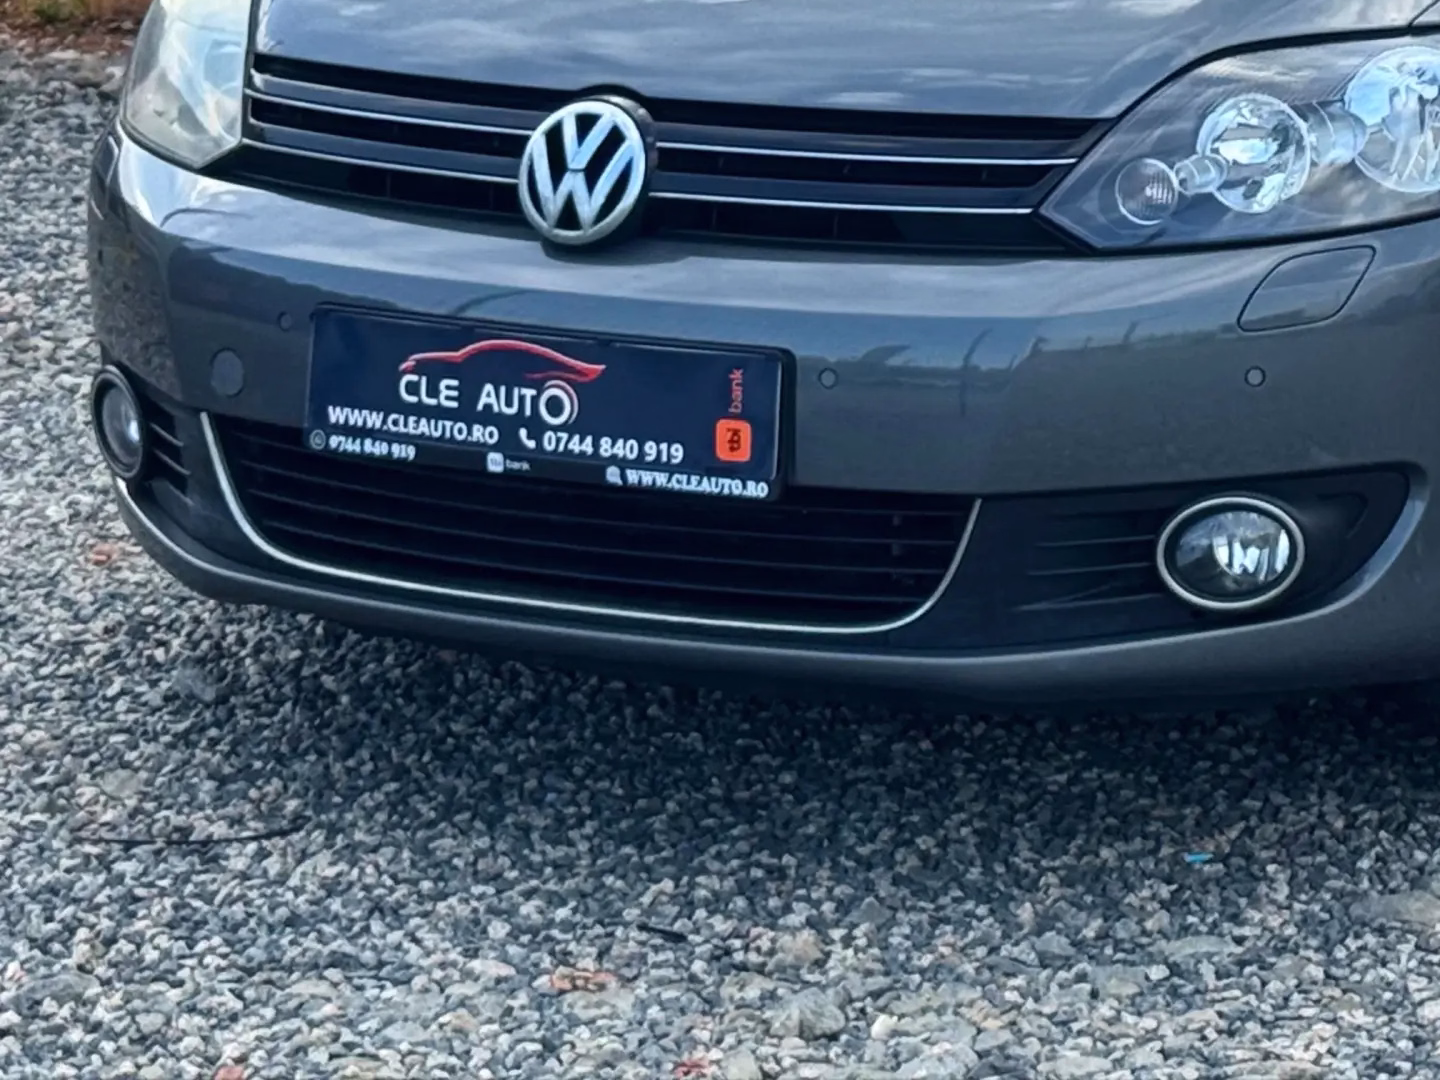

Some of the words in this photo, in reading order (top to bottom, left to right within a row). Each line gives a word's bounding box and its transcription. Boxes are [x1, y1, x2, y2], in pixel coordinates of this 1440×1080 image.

[399, 373, 460, 408] CLE
[476, 382, 573, 426] AUTO
[728, 368, 744, 414] bank
[328, 405, 499, 445] WWW.CLEAUTO.RO
[328, 434, 361, 454] 0744
[363, 437, 389, 457] 840
[391, 442, 416, 461] 919
[543, 430, 594, 456] 0744
[599, 436, 639, 461] 840
[643, 440, 685, 464] 919
[625, 468, 769, 499] WWW.CLEAUTO.RO
